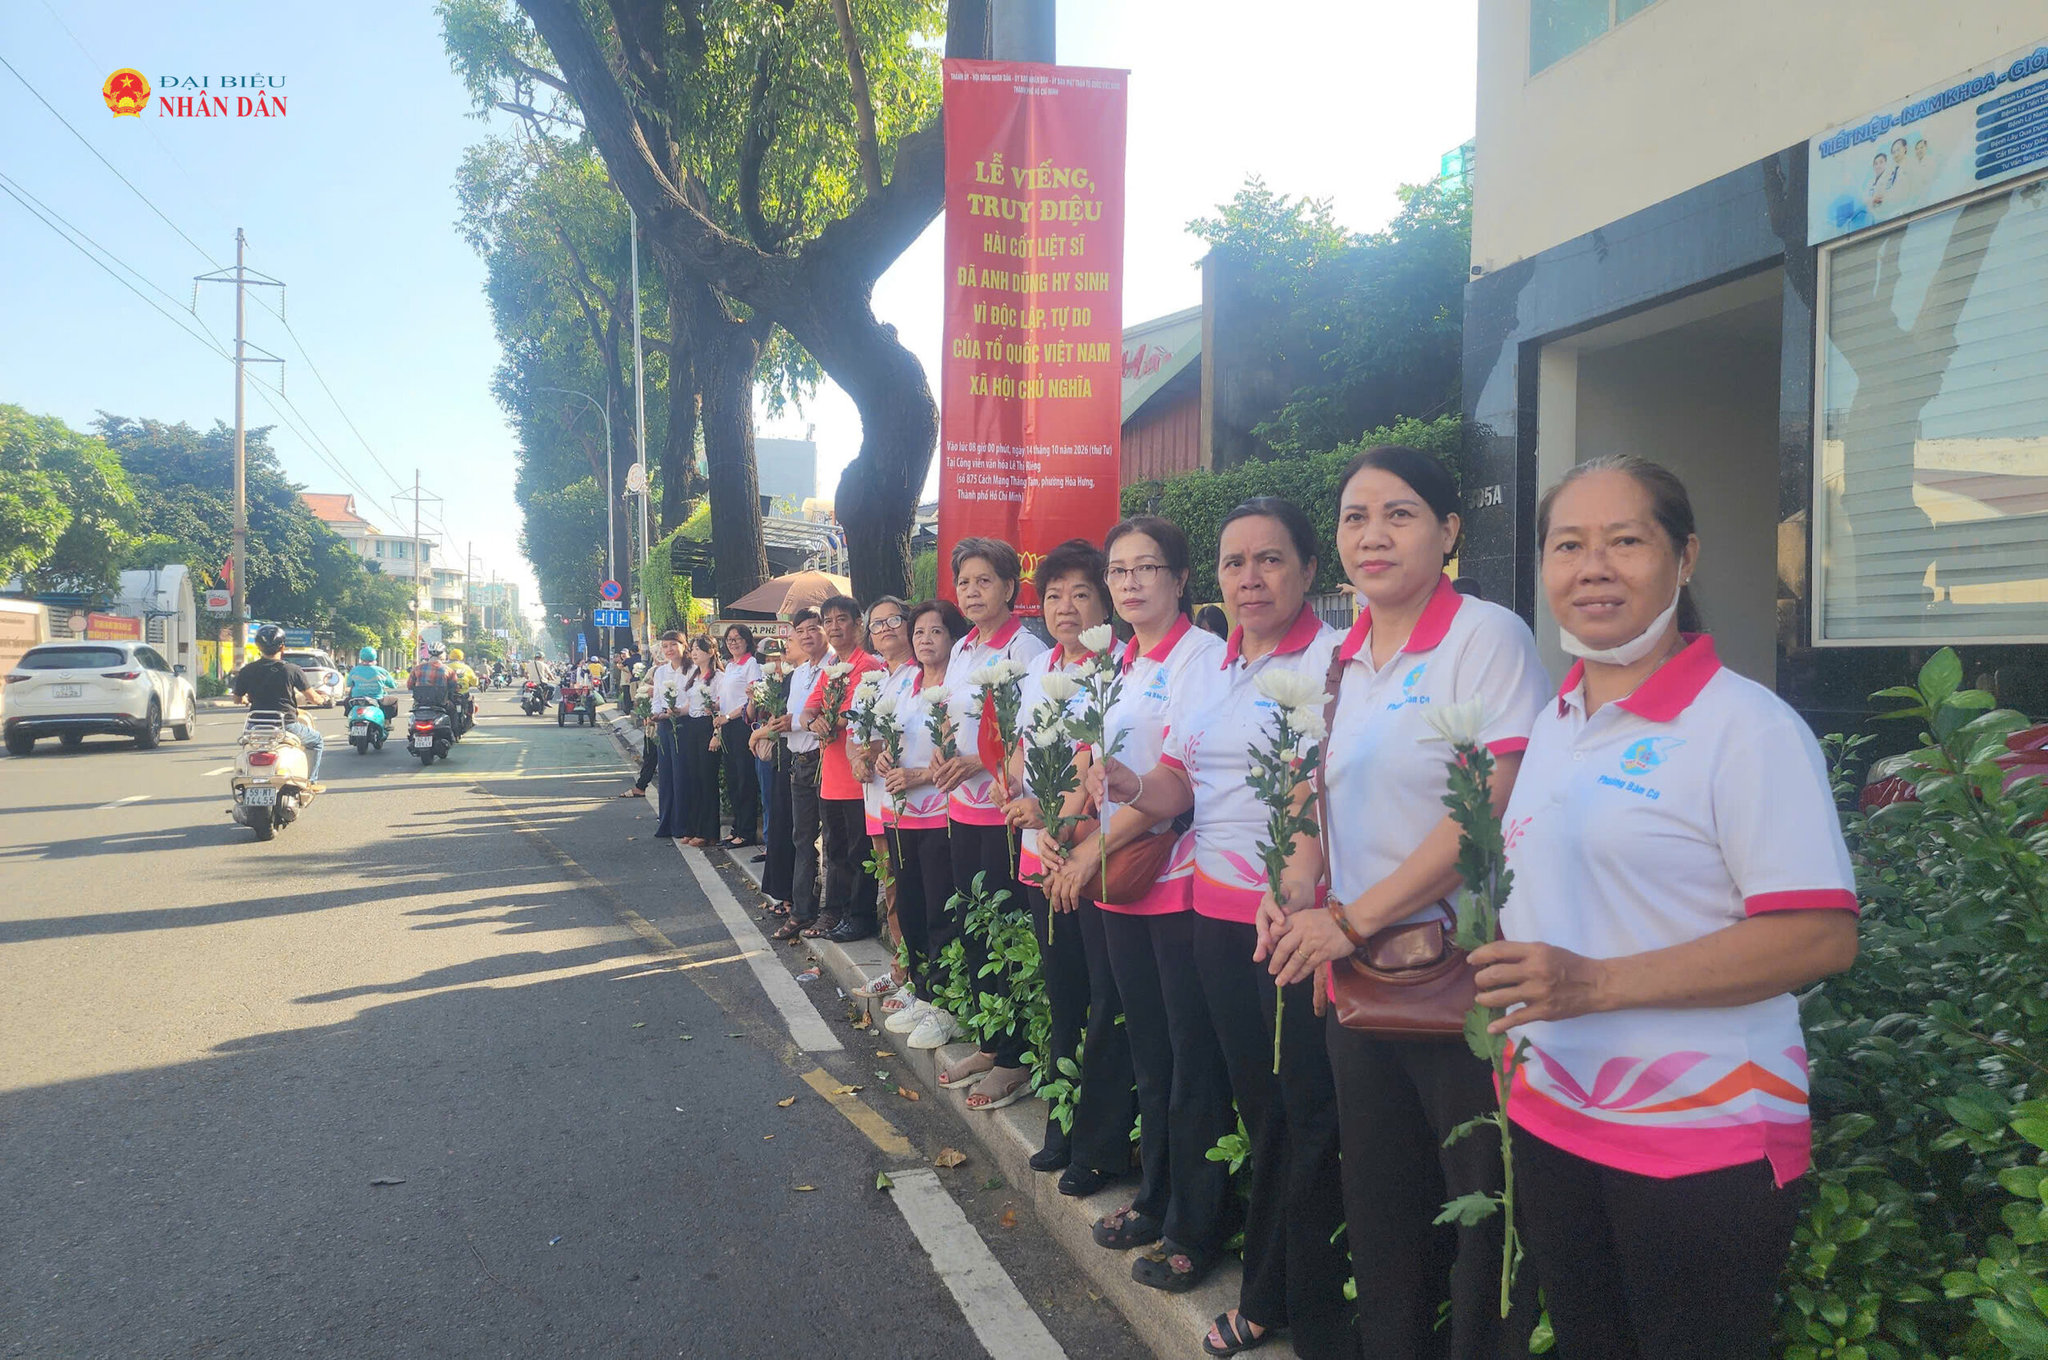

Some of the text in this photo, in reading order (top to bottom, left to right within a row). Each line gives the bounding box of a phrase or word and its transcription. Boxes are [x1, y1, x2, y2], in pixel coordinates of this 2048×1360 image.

[1901, 92, 1944, 126] NAM
[1942, 71, 1996, 110] KHOA
[975, 152, 1095, 194] LỄ VIẾNG,
[967, 193, 1103, 226] TRUY ĐIỆU
[984, 231, 1086, 260] HÀI CỐT LIỆT SĨ
[957, 263, 1110, 294] ĐÃ ANH DŨNG HY SINH
[974, 301, 1091, 333] VÌ ĐỘC LẬP, TỰ DO
[953, 333, 1111, 366] CỦA TỔ QUỐC VIỆT NAM
[969, 373, 1092, 401] XÃ HỘI CHỦ NGHĨA
[946, 441, 959, 452] Vào
[969, 442, 977, 452] 08
[988, 443, 995, 453] 00
[1026, 445, 1033, 454] 14
[1051, 445, 1059, 455] 10
[1074, 445, 1089, 455] 2026
[946, 457, 956, 470] Tại
[956, 457, 972, 470] Công
[972, 458, 985, 468] viên
[957, 489, 977, 500] Thành
[977, 489, 988, 502] phố
[989, 489, 998, 500] Hồ
[966, 474, 977, 484] 875
[978, 474, 992, 485] Cách
[993, 475, 1010, 488] Mạng
[760, 624, 777, 634] PHÊ
